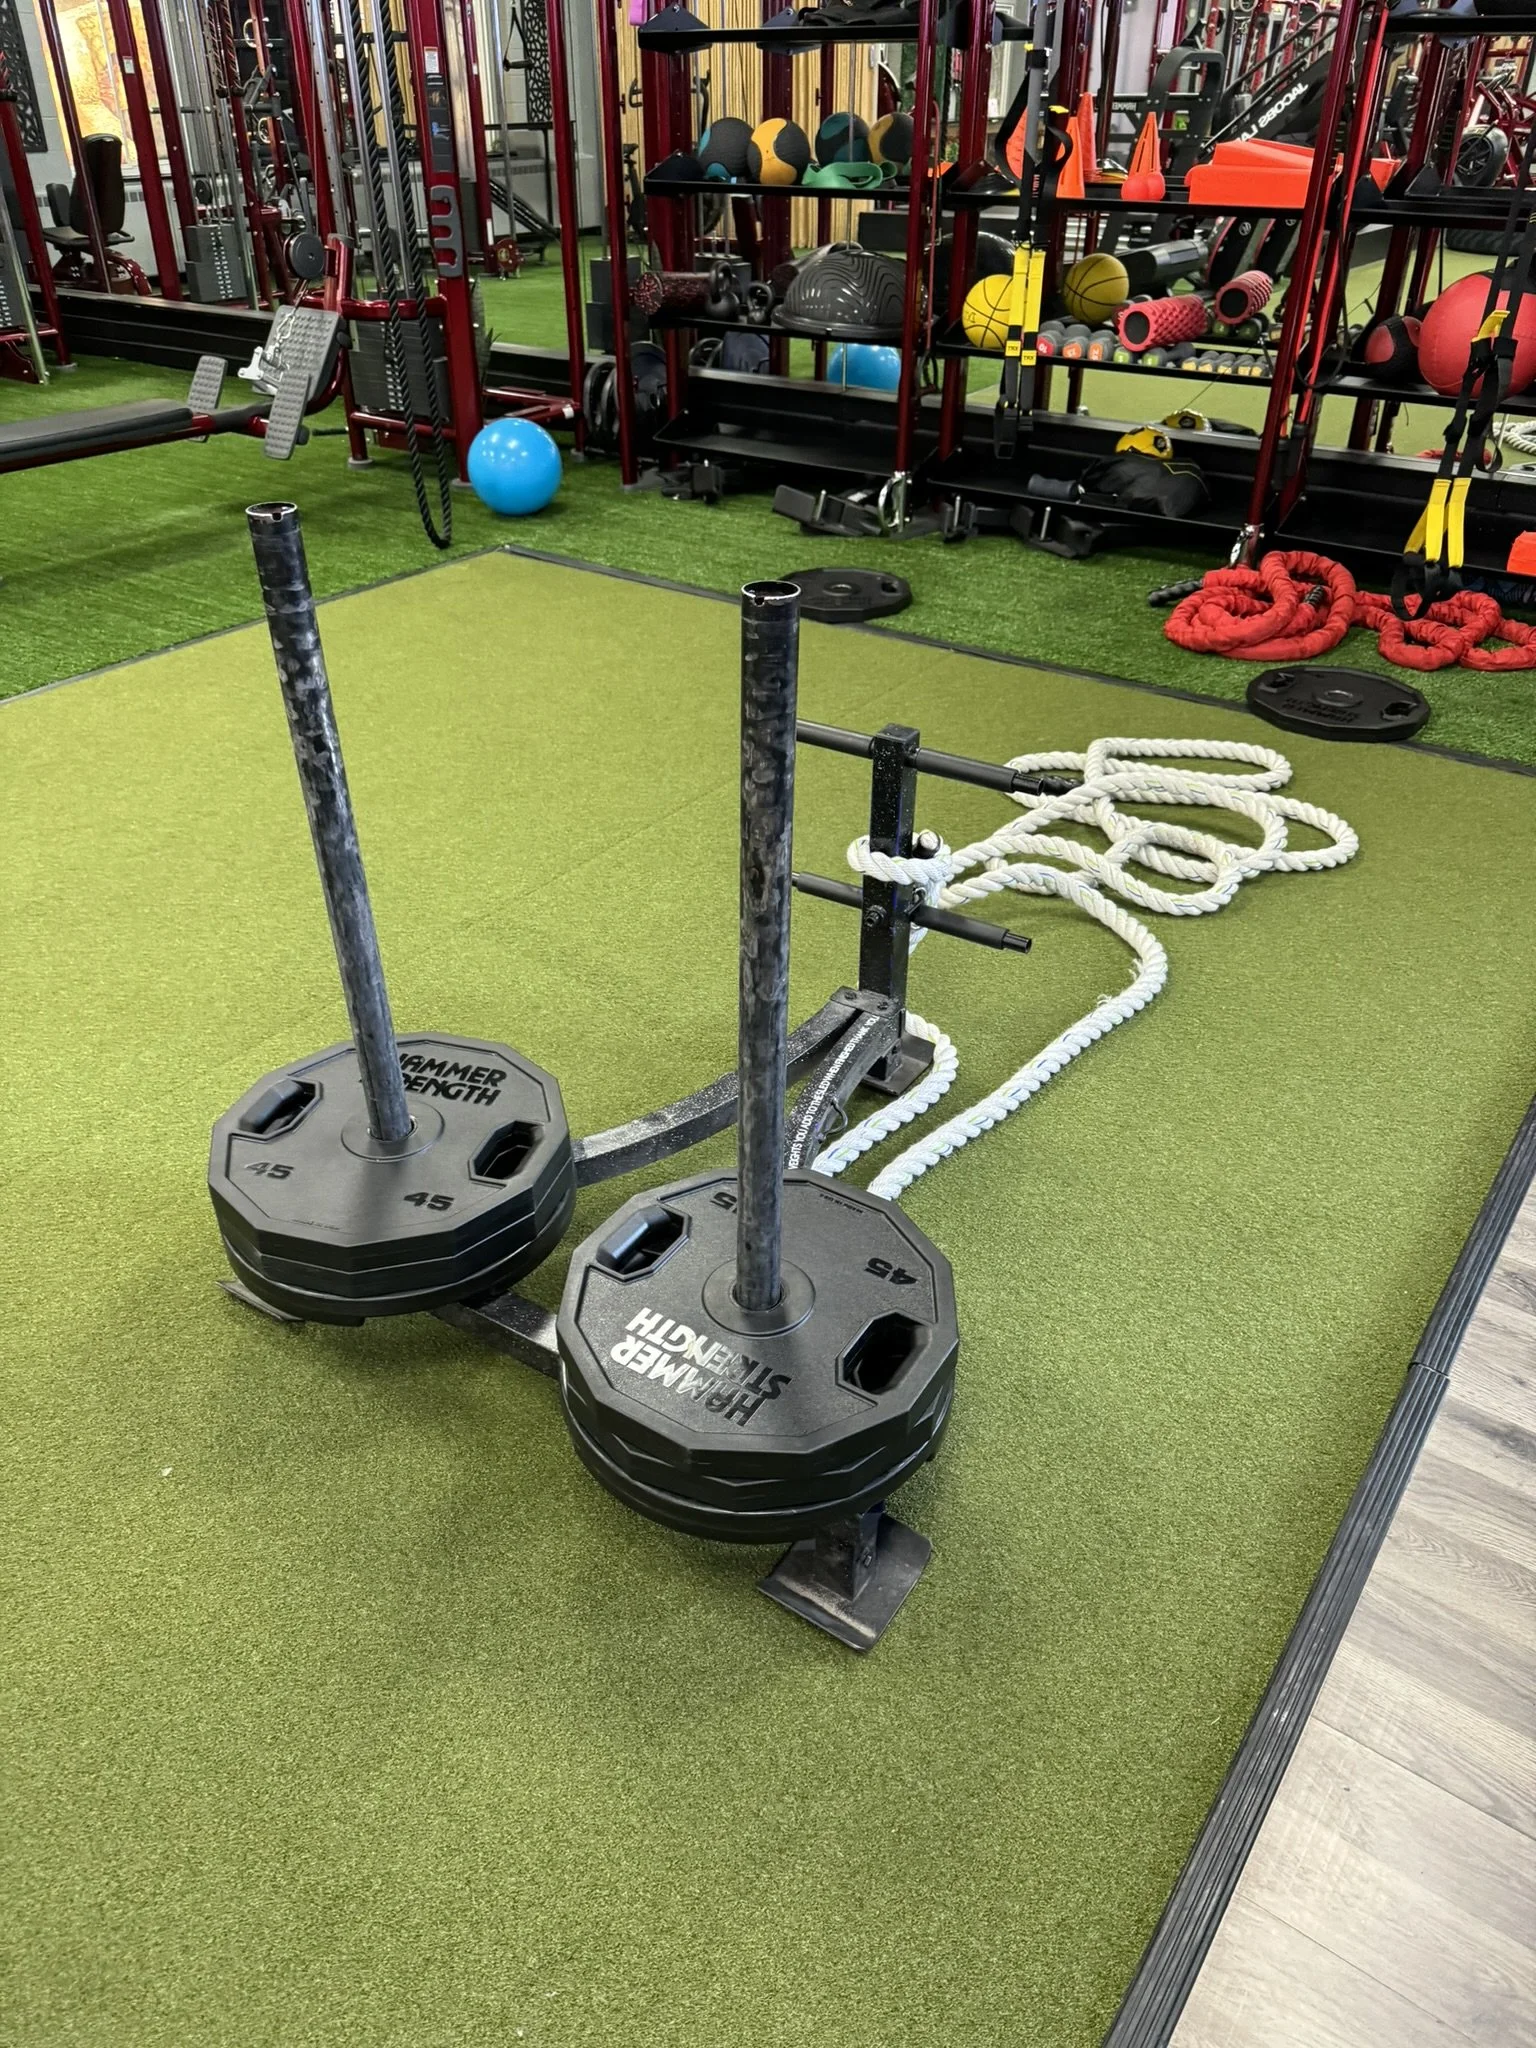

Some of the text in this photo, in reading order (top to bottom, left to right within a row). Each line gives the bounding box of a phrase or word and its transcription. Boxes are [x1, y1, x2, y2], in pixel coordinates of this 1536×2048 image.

[865, 1015, 880, 1026] YOU
[850, 1026, 870, 1043] THANK
[834, 1042, 856, 1065] FINISHED
[822, 1063, 842, 1081] WHEN
[402, 1073, 502, 1107] RENGTH
[814, 1080, 831, 1096] SLED
[806, 1104, 818, 1115] TO
[811, 1094, 824, 1106] THE
[801, 1114, 814, 1130] ADD
[793, 1128, 808, 1142] YOU
[246, 1161, 295, 1181] 45
[403, 1191, 455, 1213] 45
[709, 1191, 738, 1214] 5
[864, 1257, 918, 1287] 45
[625, 1306, 792, 1401] STRENGTH
[610, 1334, 768, 1428] HAMMER
